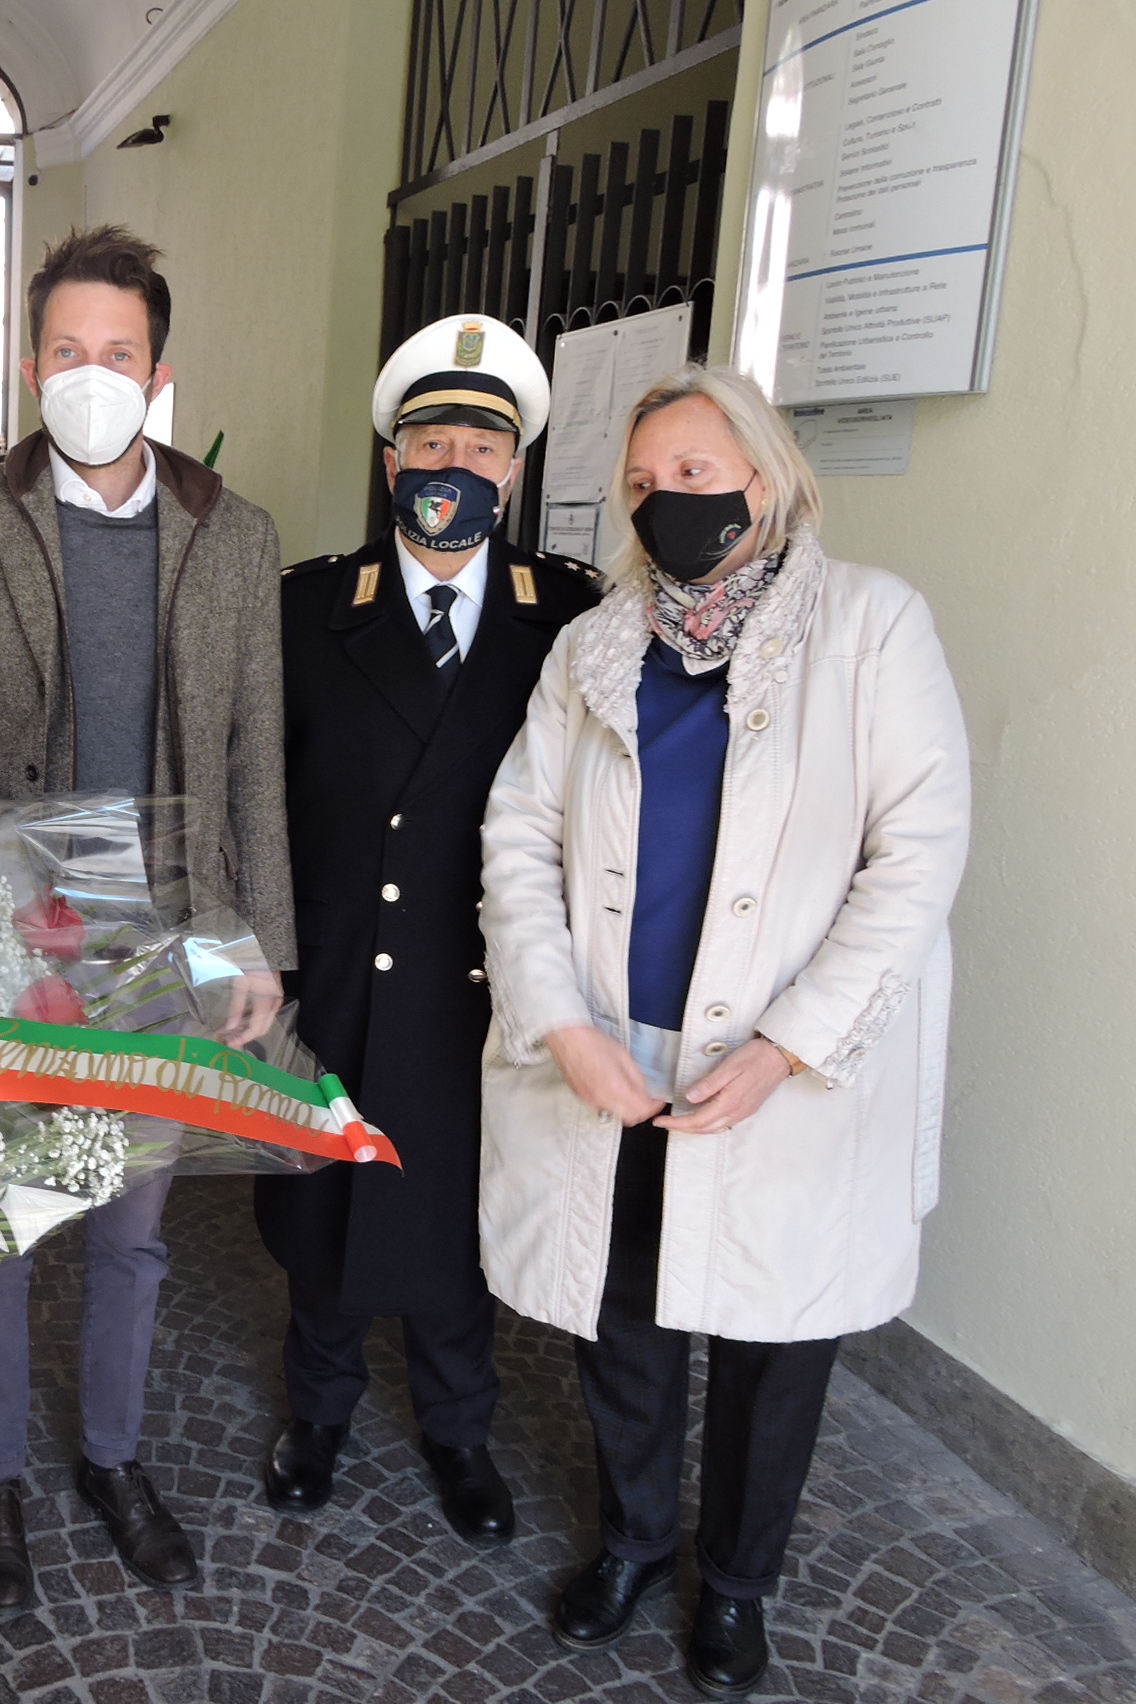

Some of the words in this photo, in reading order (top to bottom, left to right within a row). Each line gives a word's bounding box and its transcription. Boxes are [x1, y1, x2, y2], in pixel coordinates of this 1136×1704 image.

[430, 531, 482, 548] LOCALE
[155, 1038, 205, 1099] di
[209, 1050, 329, 1138] Roma
